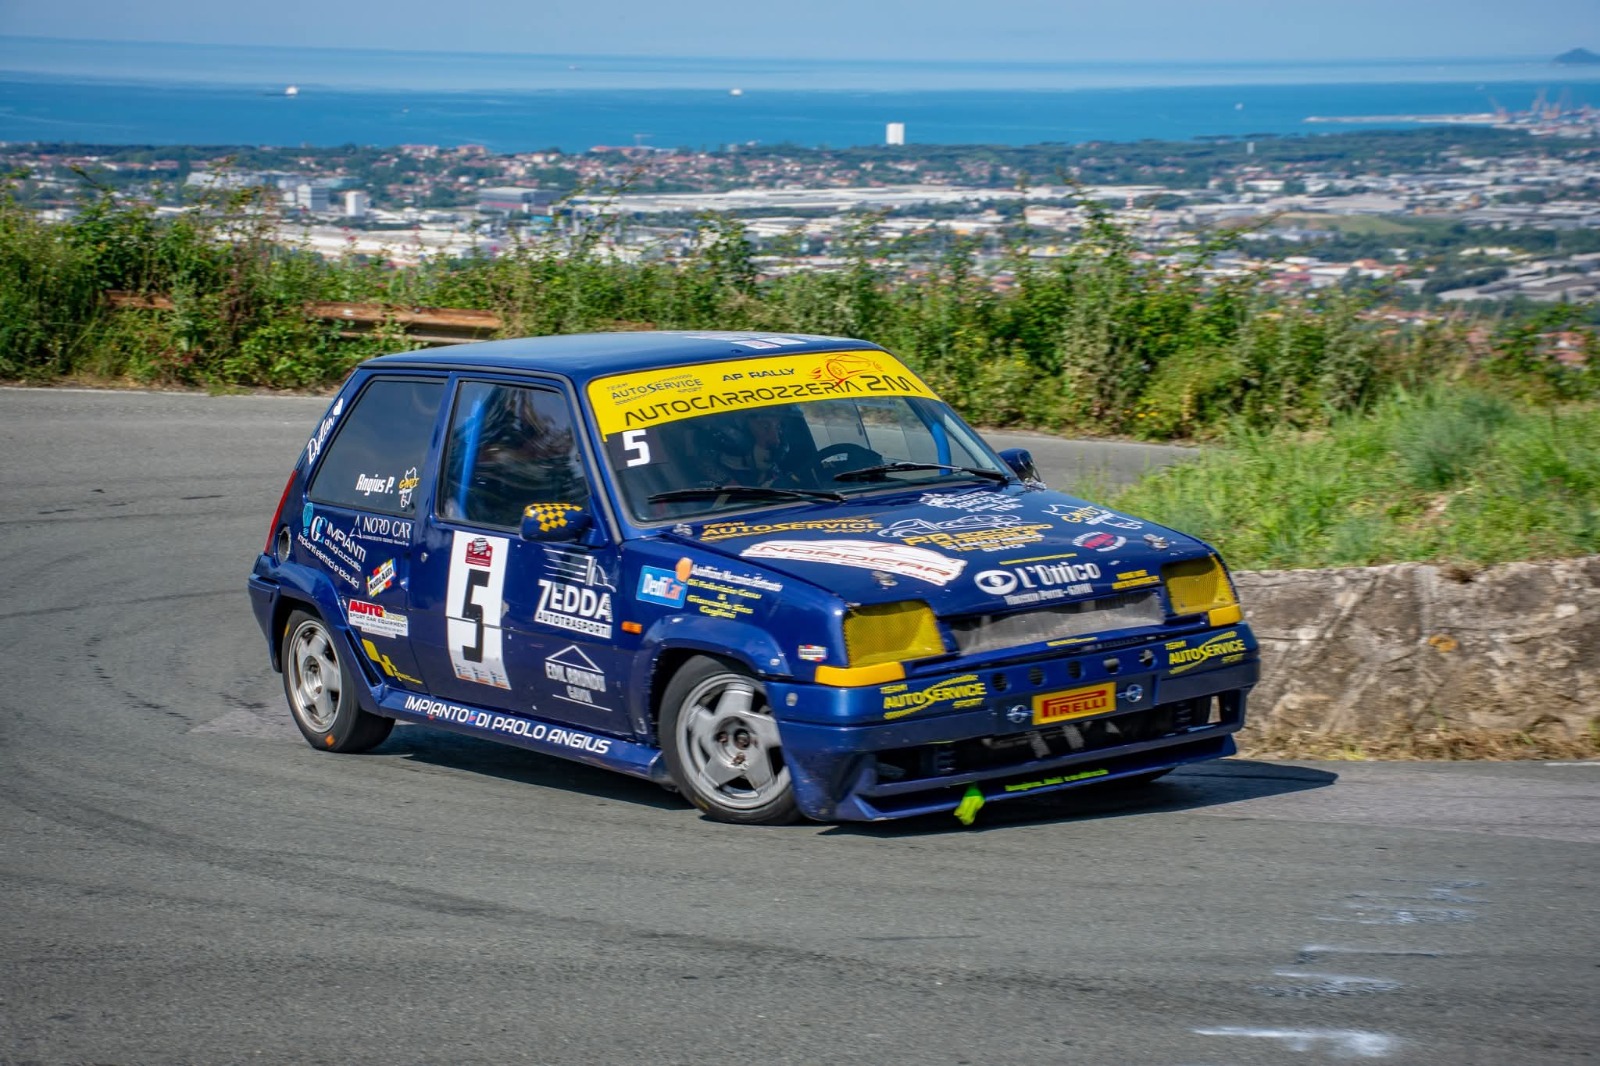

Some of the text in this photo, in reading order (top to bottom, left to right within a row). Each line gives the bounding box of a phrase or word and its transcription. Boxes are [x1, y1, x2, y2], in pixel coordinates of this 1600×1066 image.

[612, 378, 704, 399] AUTOSERVICE
[722, 368, 796, 382] AP RALLY
[625, 375, 922, 426] AUTOCARROZZERIA 2M
[622, 429, 651, 467] 5
[355, 473, 395, 496] Angius P.
[363, 516, 411, 538] NORD CAR
[701, 522, 885, 537] AUTOSERVICE
[327, 521, 367, 563] IMPIANTI
[538, 579, 613, 623] ZEDDA
[462, 568, 491, 664] 5
[537, 611, 612, 638] AUTOTRASPORTI
[1168, 639, 1247, 665] AUTOSERVICE
[883, 682, 988, 709] AUTOSERVICE
[1042, 689, 1107, 718] PIRELLI
[404, 696, 613, 754] IMPIANTO DI PAOLO ANGIUS
